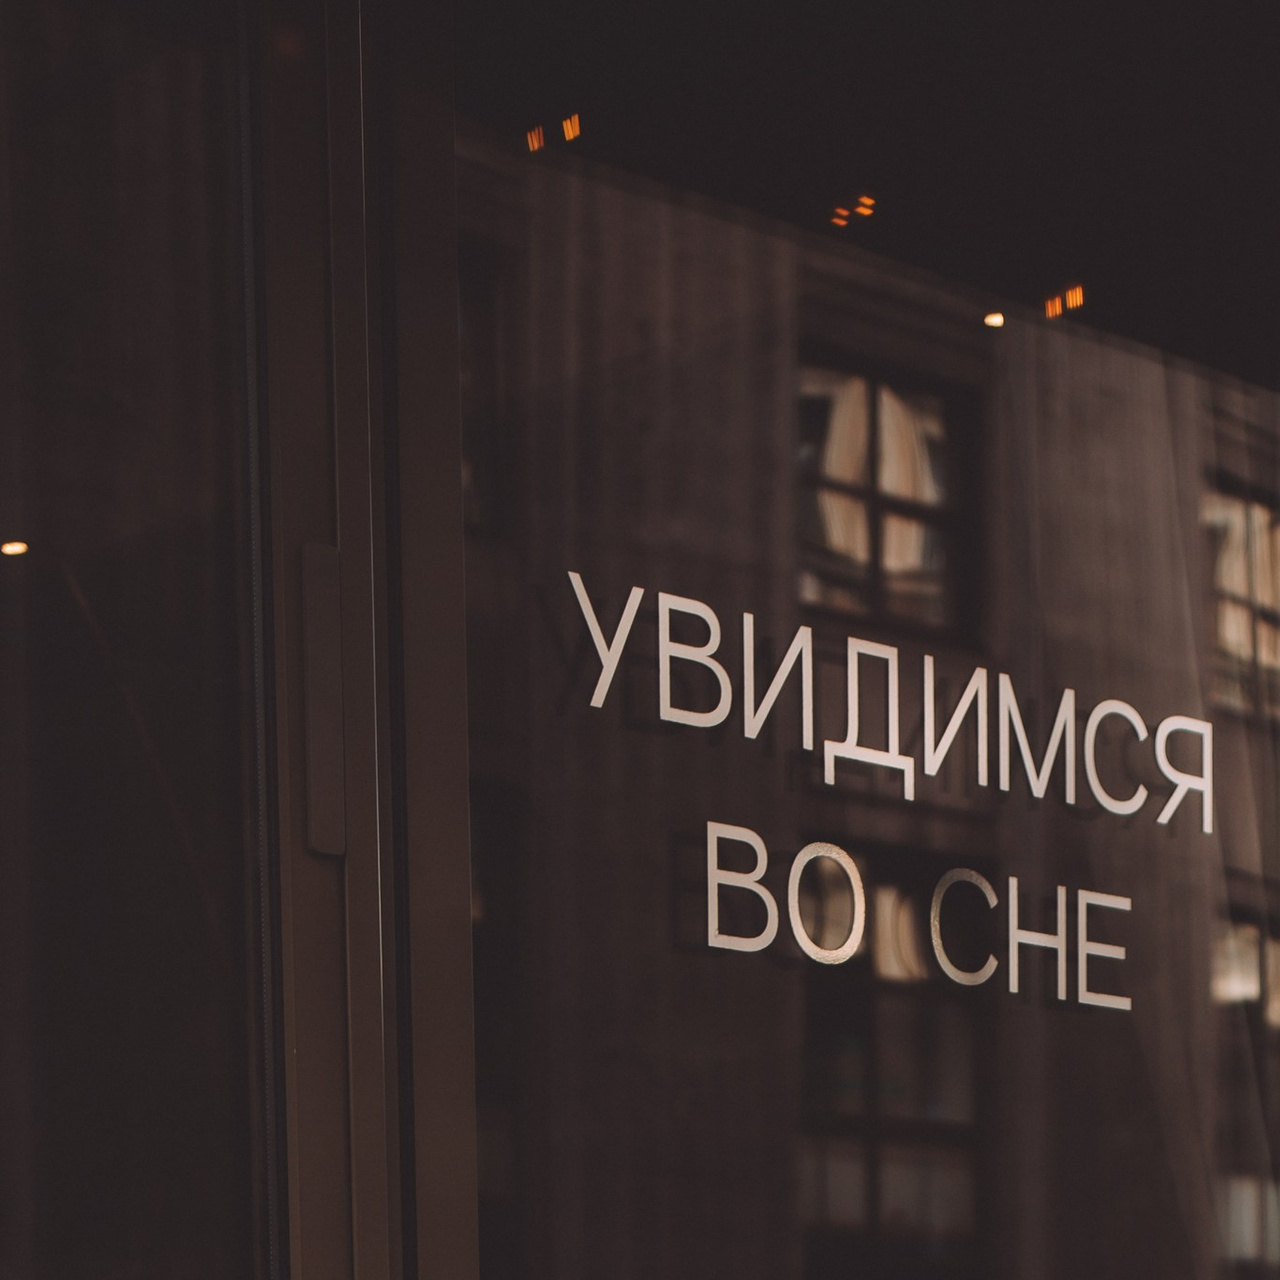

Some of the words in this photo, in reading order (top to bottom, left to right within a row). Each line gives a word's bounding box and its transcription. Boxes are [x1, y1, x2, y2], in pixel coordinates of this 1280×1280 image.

[567, 571, 1213, 833] УВИДИМСЯ
[707, 821, 865, 965] ВО
[930, 868, 1131, 1010] СНЕ
